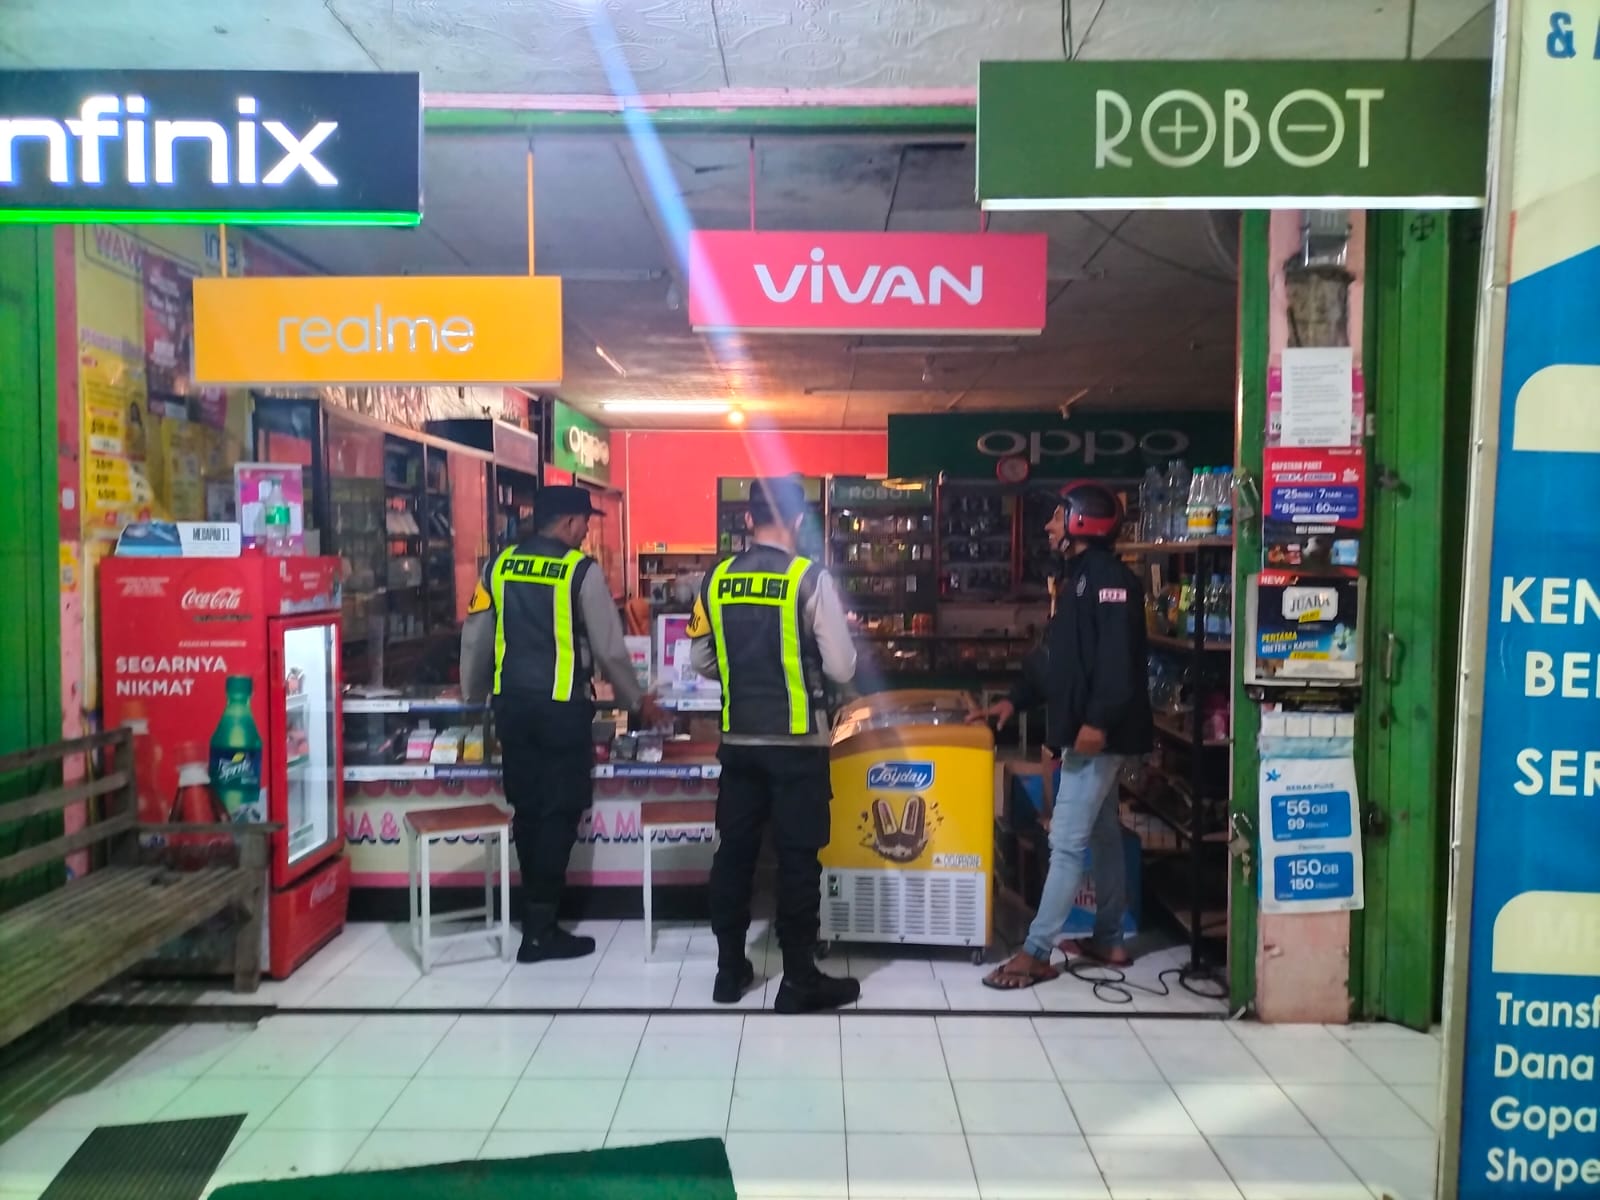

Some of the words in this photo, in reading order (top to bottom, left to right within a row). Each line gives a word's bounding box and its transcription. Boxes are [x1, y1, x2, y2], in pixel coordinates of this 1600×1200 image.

[1547, 12, 1576, 58] &
[1096, 89, 1384, 169] ROBOT
[279, 304, 474, 354] realme
[500, 559, 568, 580] POLISI
[717, 577, 789, 600] POLISI
[1261, 576, 1285, 585] NEW
[1261, 631, 1297, 642] PERTAMA
[115, 656, 228, 673] SEGARNYA
[1524, 650, 1600, 698] BE
[116, 679, 195, 696] NIKMAT
[1286, 800, 1311, 816] 56
[1287, 818, 1305, 830] 99
[1288, 859, 1321, 876] 150
[1289, 878, 1314, 890] 150
[1494, 1044, 1594, 1081] Dana
